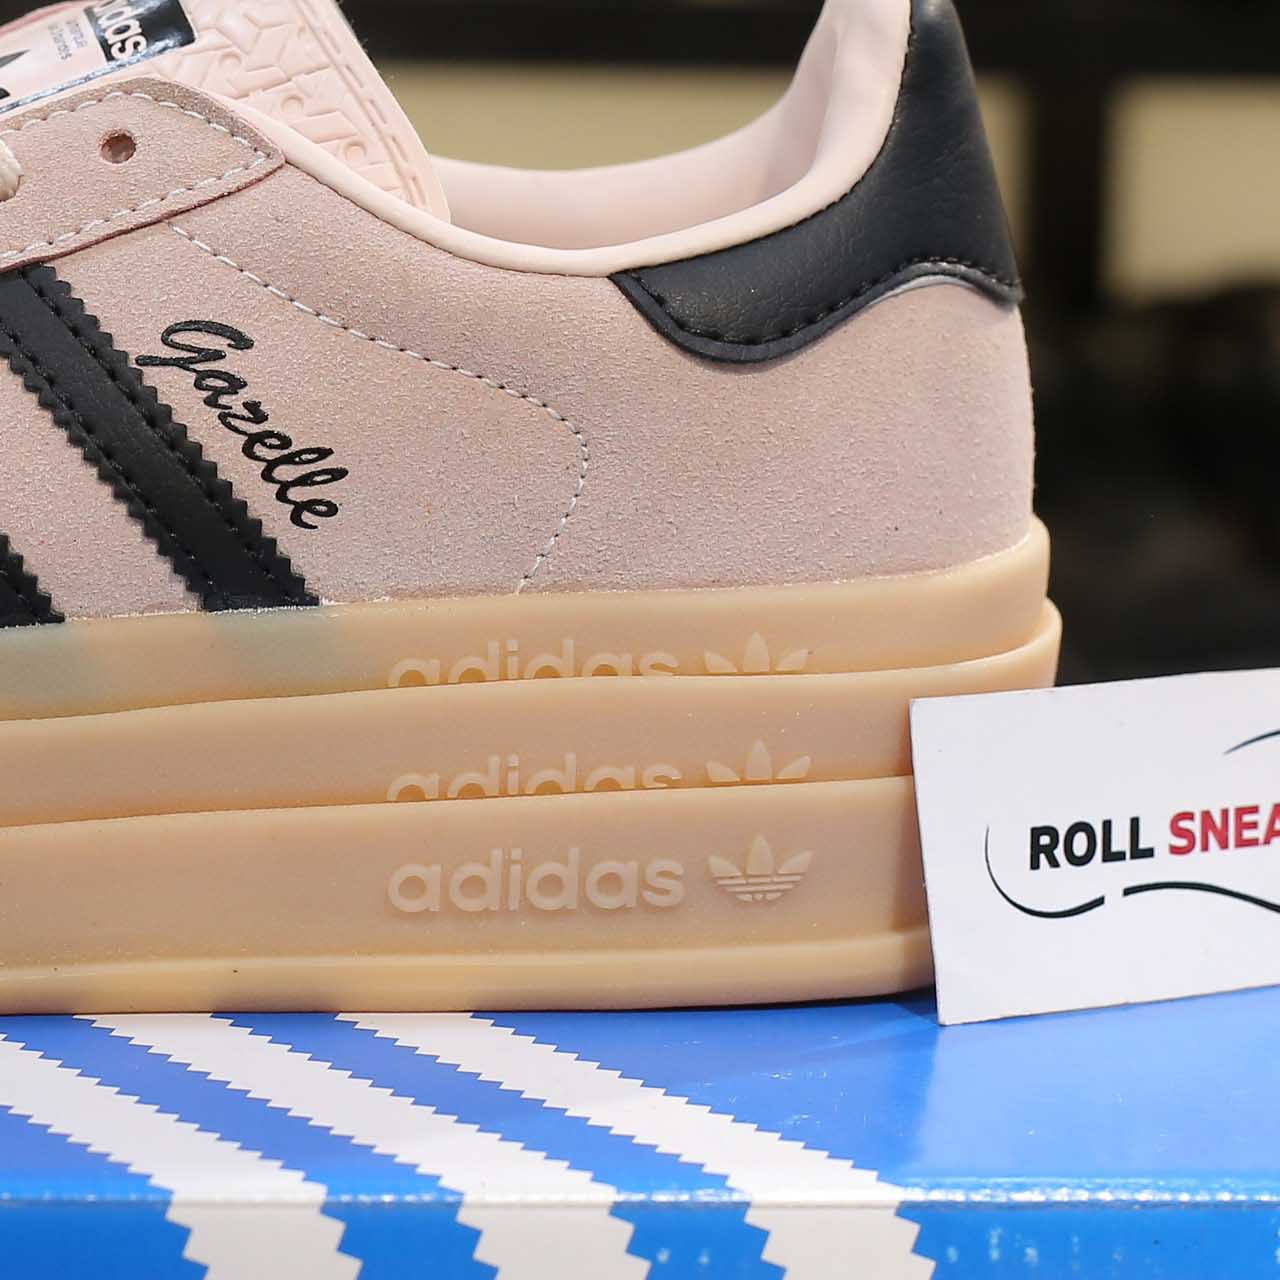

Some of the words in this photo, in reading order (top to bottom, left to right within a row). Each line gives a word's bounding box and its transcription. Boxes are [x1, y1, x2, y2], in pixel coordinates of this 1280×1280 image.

[135, 320, 349, 530] Gazelle
[1029, 816, 1155, 871] ROLL
[388, 847, 687, 913] adidas
